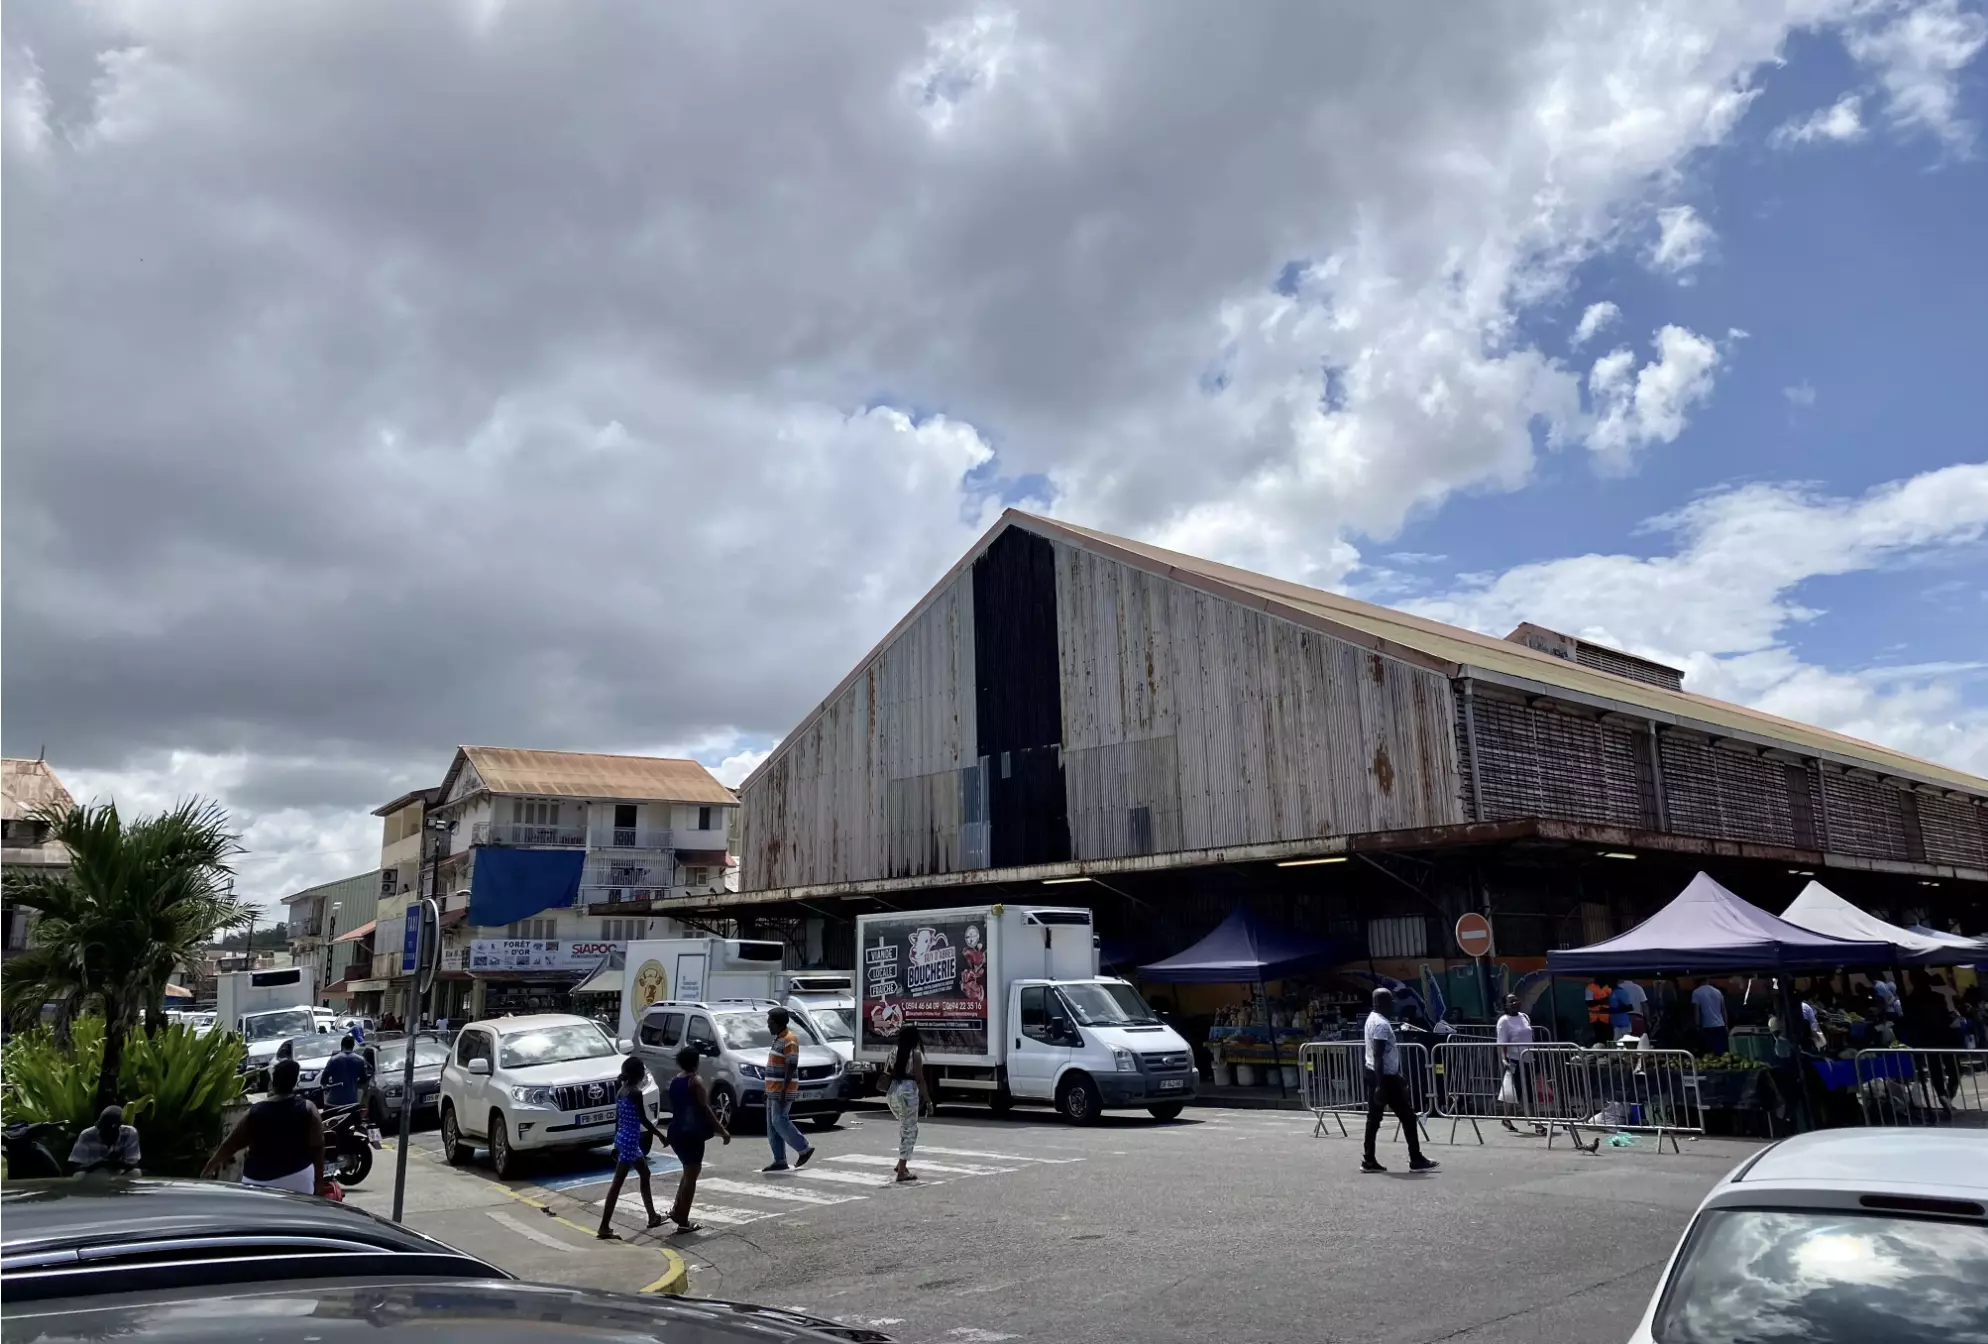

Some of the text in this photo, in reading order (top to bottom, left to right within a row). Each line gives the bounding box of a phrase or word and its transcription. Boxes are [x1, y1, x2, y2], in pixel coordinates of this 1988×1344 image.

[870, 948, 893, 960] VIANDE
[872, 967, 893, 978] LOCALE
[908, 958, 955, 987] BOUCHERIE
[975, 1001, 982, 1010] 16
